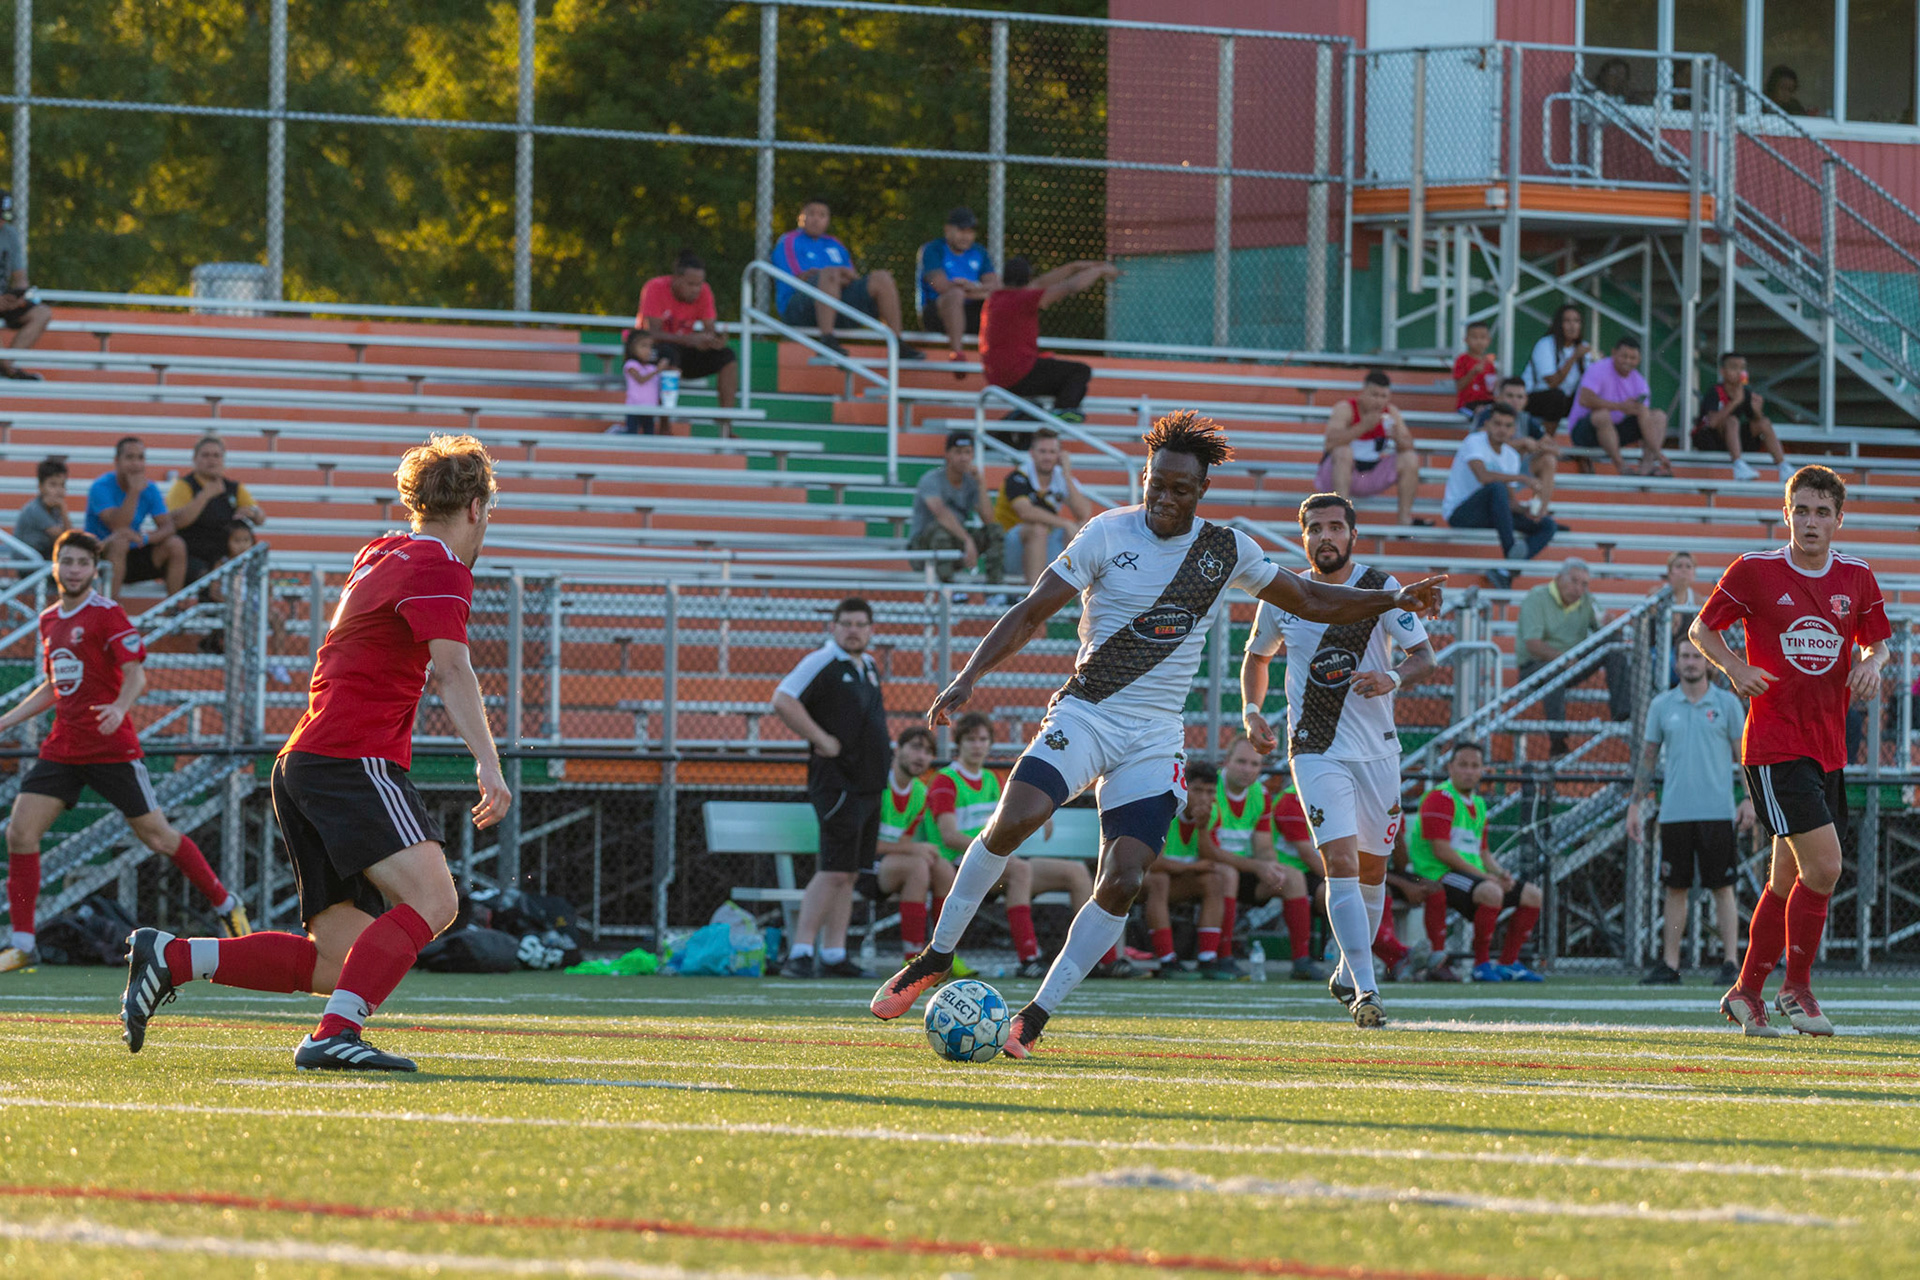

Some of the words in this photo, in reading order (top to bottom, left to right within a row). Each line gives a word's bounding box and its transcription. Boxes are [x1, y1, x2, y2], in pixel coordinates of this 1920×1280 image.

[1786, 637, 1805, 648] TIN
[1808, 639, 1838, 649] ROOF
[1384, 823, 1397, 844] 9
[940, 989, 977, 1020] SELECT
